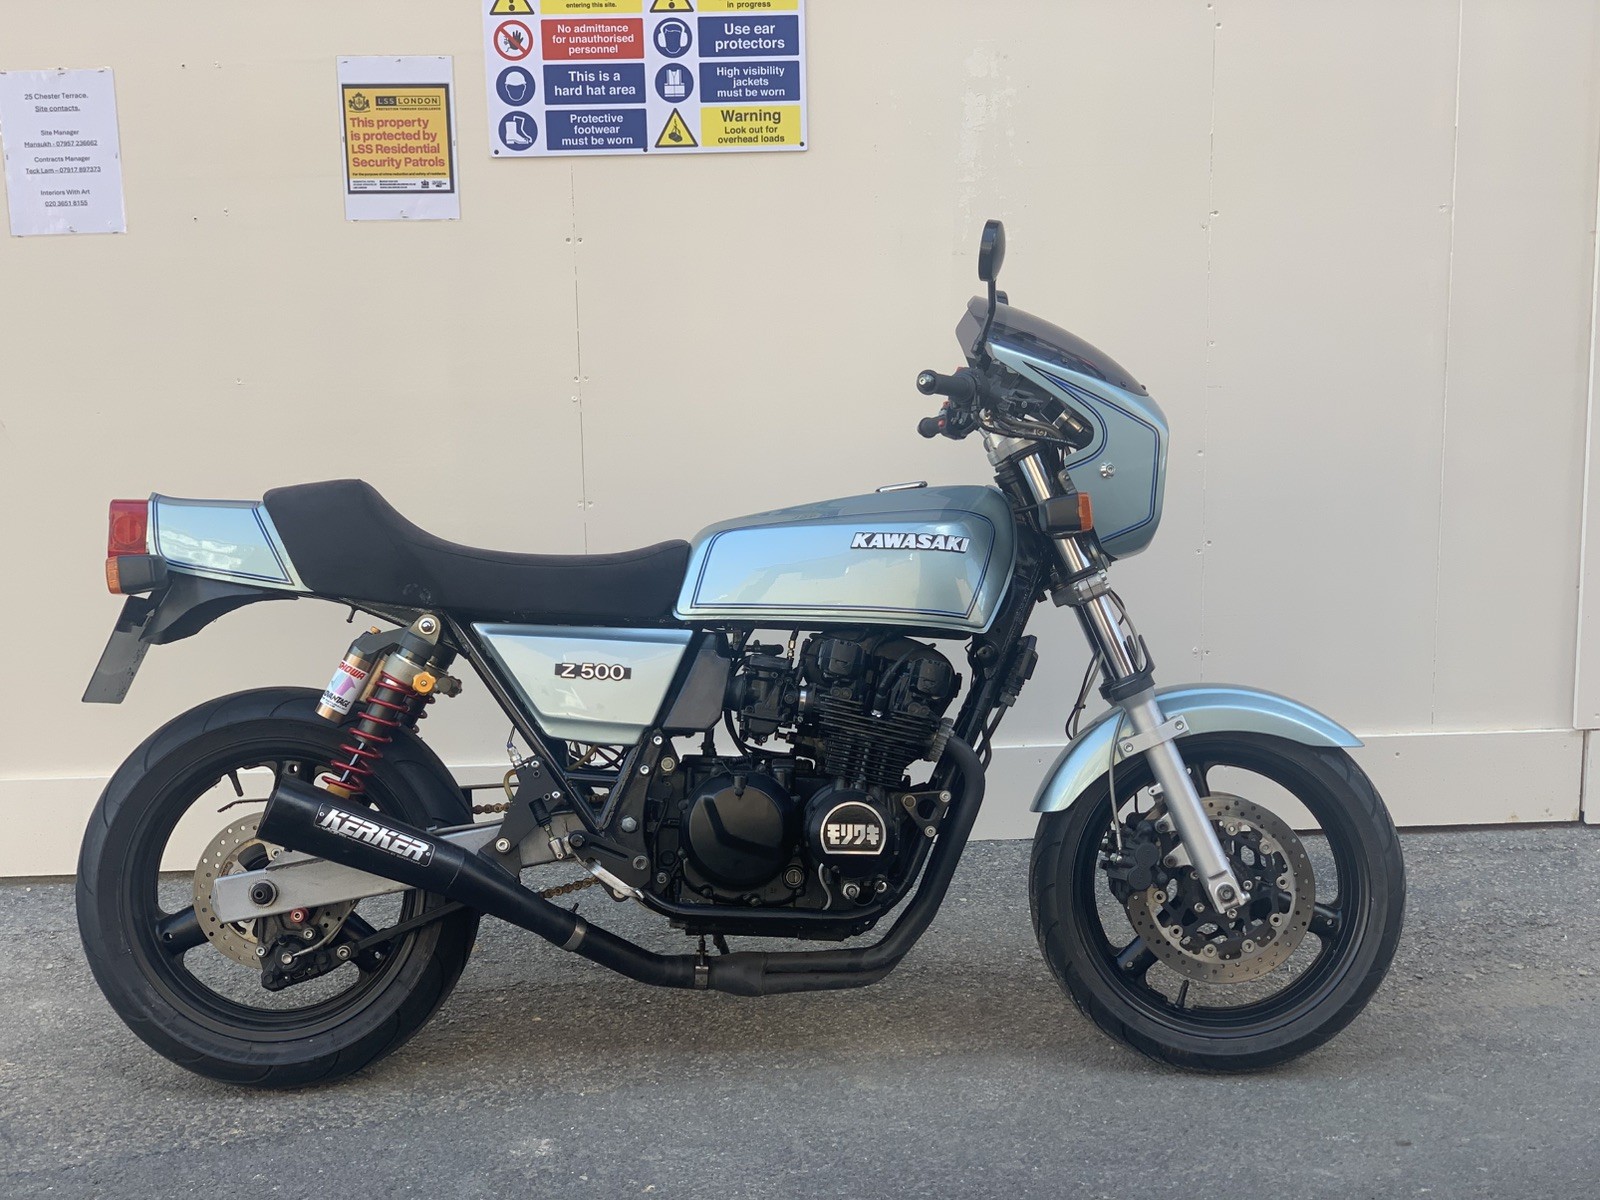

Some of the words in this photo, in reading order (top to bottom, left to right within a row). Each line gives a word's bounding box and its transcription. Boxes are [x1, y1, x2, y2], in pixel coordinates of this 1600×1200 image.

[736, 1, 771, 9] progress
[557, 25, 571, 33] No
[574, 24, 628, 33] admittance
[724, 23, 750, 35] Use
[754, 25, 775, 34] ear
[552, 35, 566, 43] for
[569, 34, 634, 43] unauthorised
[569, 45, 618, 56] personnel
[715, 38, 785, 52] protectors
[568, 71, 595, 81] This
[599, 71, 609, 81] is
[613, 73, 620, 81] a
[716, 67, 740, 78] High
[743, 66, 784, 77] visibility
[733, 78, 768, 88] jackets
[554, 85, 582, 96] hard
[586, 85, 605, 95] hat
[609, 86, 636, 95] area
[745, 88, 757, 97] be
[570, 114, 623, 123] Protective
[721, 109, 781, 124] Warning
[350, 117, 374, 127] This
[377, 118, 429, 129] property
[53, 129, 79, 137] Manager
[574, 125, 620, 134] footwear
[724, 126, 747, 134] Look
[351, 131, 360, 140] is
[363, 130, 420, 142] protected
[423, 130, 437, 142] by
[562, 137, 587, 145] must
[591, 136, 604, 145] be
[607, 137, 633, 145] worn
[718, 135, 758, 143] overhead
[351, 144, 373, 154] LSS
[376, 143, 440, 154] Residential
[352, 157, 401, 169] Security
[404, 156, 445, 167] Patrols
[851, 532, 970, 553] KAWASAKI
[319, 808, 429, 861] KERKER
[827, 823, 880, 845] モリワキ
